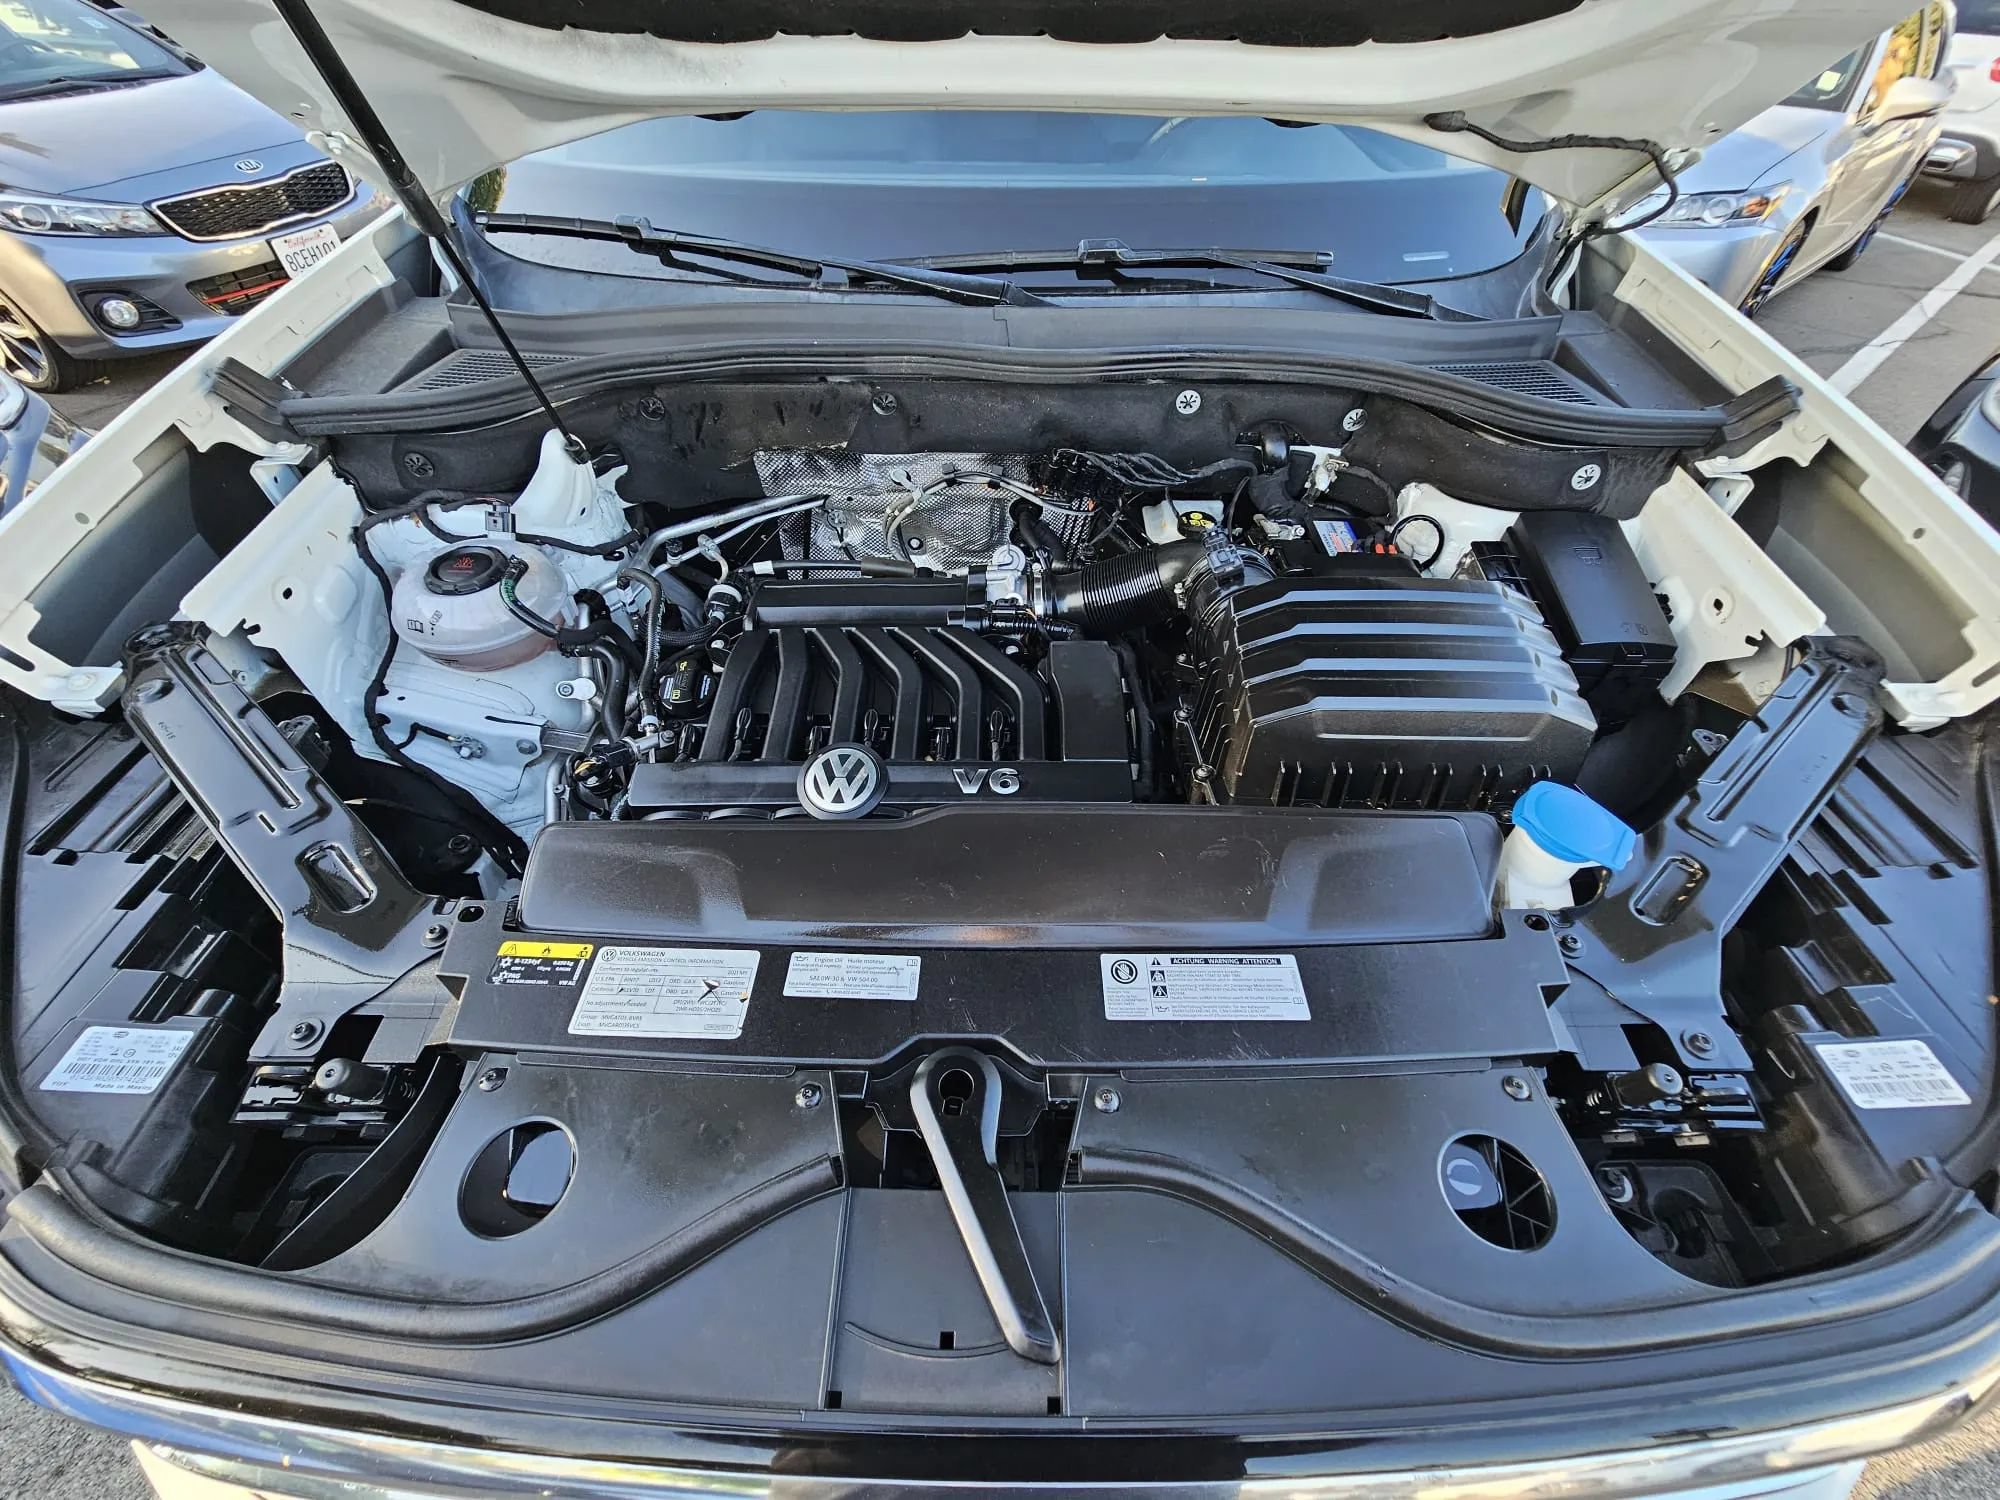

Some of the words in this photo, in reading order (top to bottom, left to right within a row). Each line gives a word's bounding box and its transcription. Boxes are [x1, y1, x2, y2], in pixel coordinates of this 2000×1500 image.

[235, 160, 262, 172] KIA
[805, 748, 877, 812] VW
[953, 768, 1020, 794] V6
